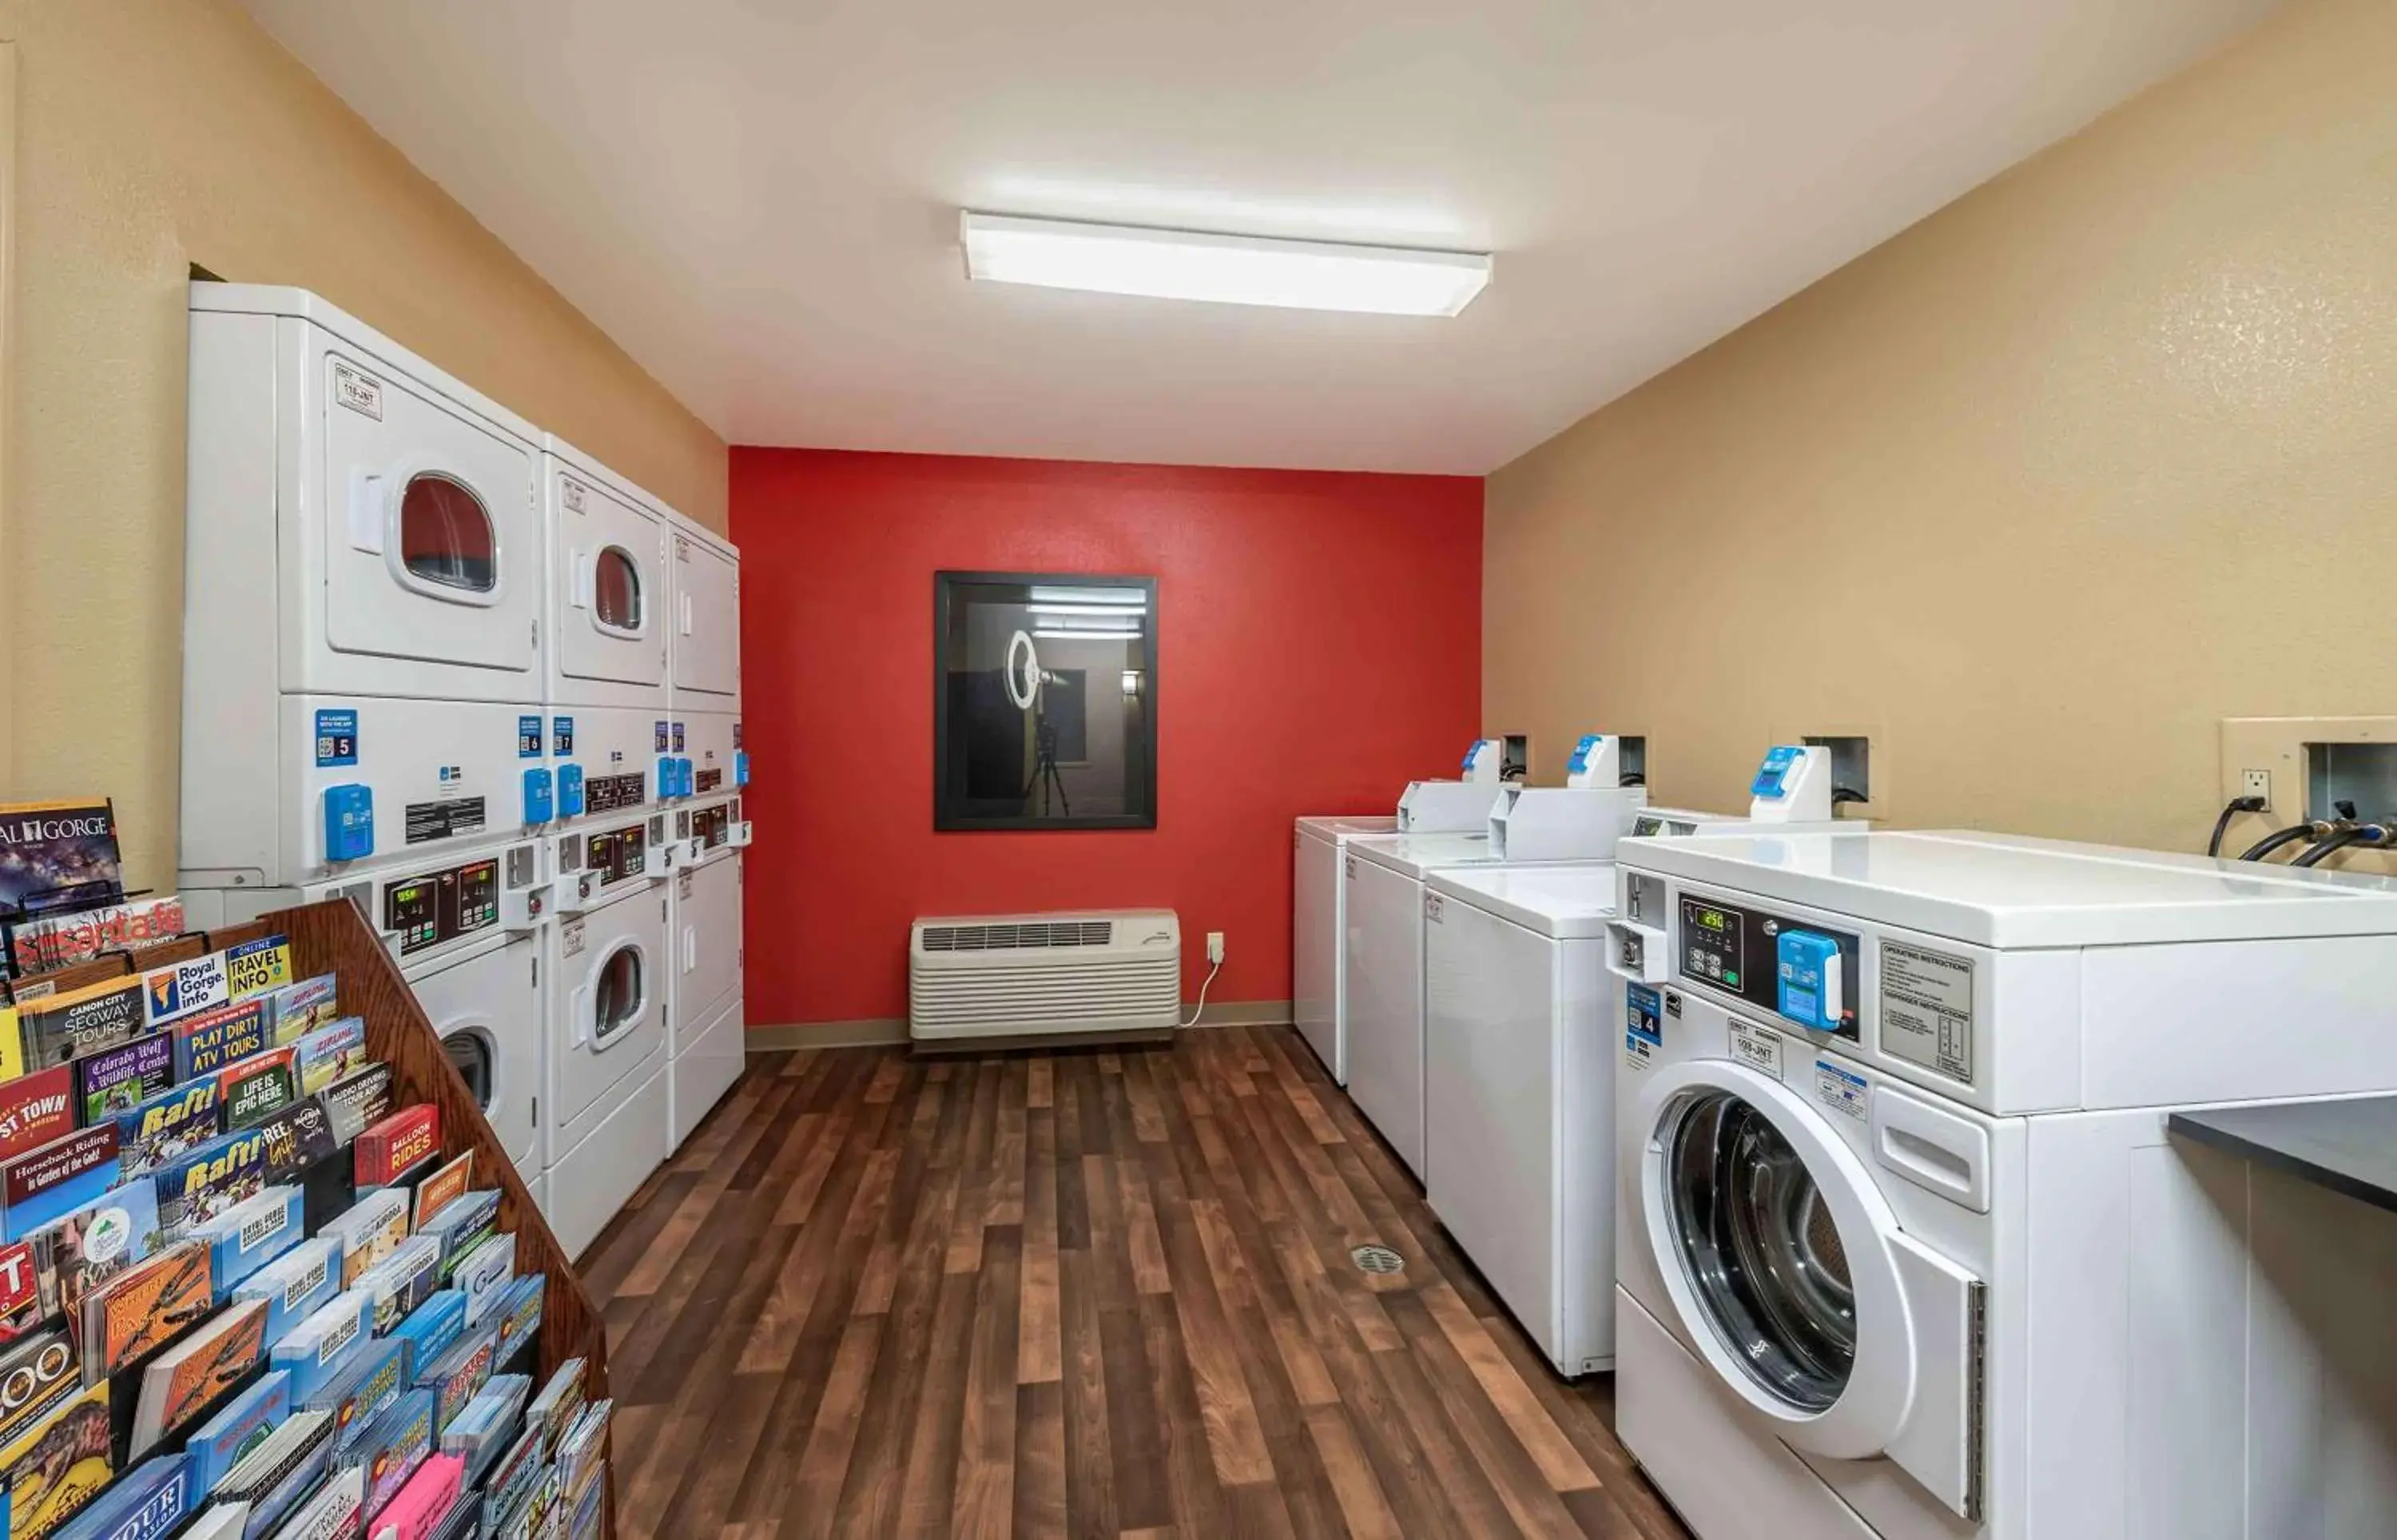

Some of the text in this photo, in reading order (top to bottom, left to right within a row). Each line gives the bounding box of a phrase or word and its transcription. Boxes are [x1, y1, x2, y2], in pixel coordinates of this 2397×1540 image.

[340, 739, 349, 755] 5
[531, 737, 538, 749] 6
[564, 736, 570, 748] 7
[43, 817, 108, 840] GORGE
[237, 940, 271, 955] ONLINE
[1883, 945, 1970, 973] OPERATING INSTRUCTIONS
[178, 959, 216, 982] Royal
[230, 949, 282, 977] TRAVEL
[180, 972, 225, 994] Gorge.
[233, 970, 268, 994] INFO
[105, 993, 126, 1006] CITY
[181, 991, 209, 1009] info
[65, 1001, 133, 1034] SEGWAY
[1646, 1018, 1654, 1033] 4
[72, 1018, 128, 1046] TOURS
[193, 1026, 222, 1054] PLAY
[226, 1015, 258, 1039] DIRTY
[92, 1038, 163, 1075] Colorado Wolf
[194, 1033, 260, 1073] ATV TOURS
[87, 1080, 95, 1093] &
[97, 1064, 136, 1087] Wildlife
[138, 1054, 169, 1073] Center
[244, 1074, 274, 1098] LIFE IS
[332, 1069, 387, 1104] AUDIO DRIVING
[20, 1093, 67, 1123] TOWN
[140, 1082, 217, 1139] Raft!
[235, 1082, 282, 1116] EPIC HERE
[344, 1091, 365, 1108] TOUR
[261, 1121, 288, 1147] REE
[392, 1121, 431, 1153] BALLOON
[15, 1132, 110, 1179] Horseback Riding
[184, 1133, 262, 1196] Raft!
[392, 1133, 432, 1171] RIDES
[62, 1161, 70, 1176] of
[70, 1157, 82, 1171] the
